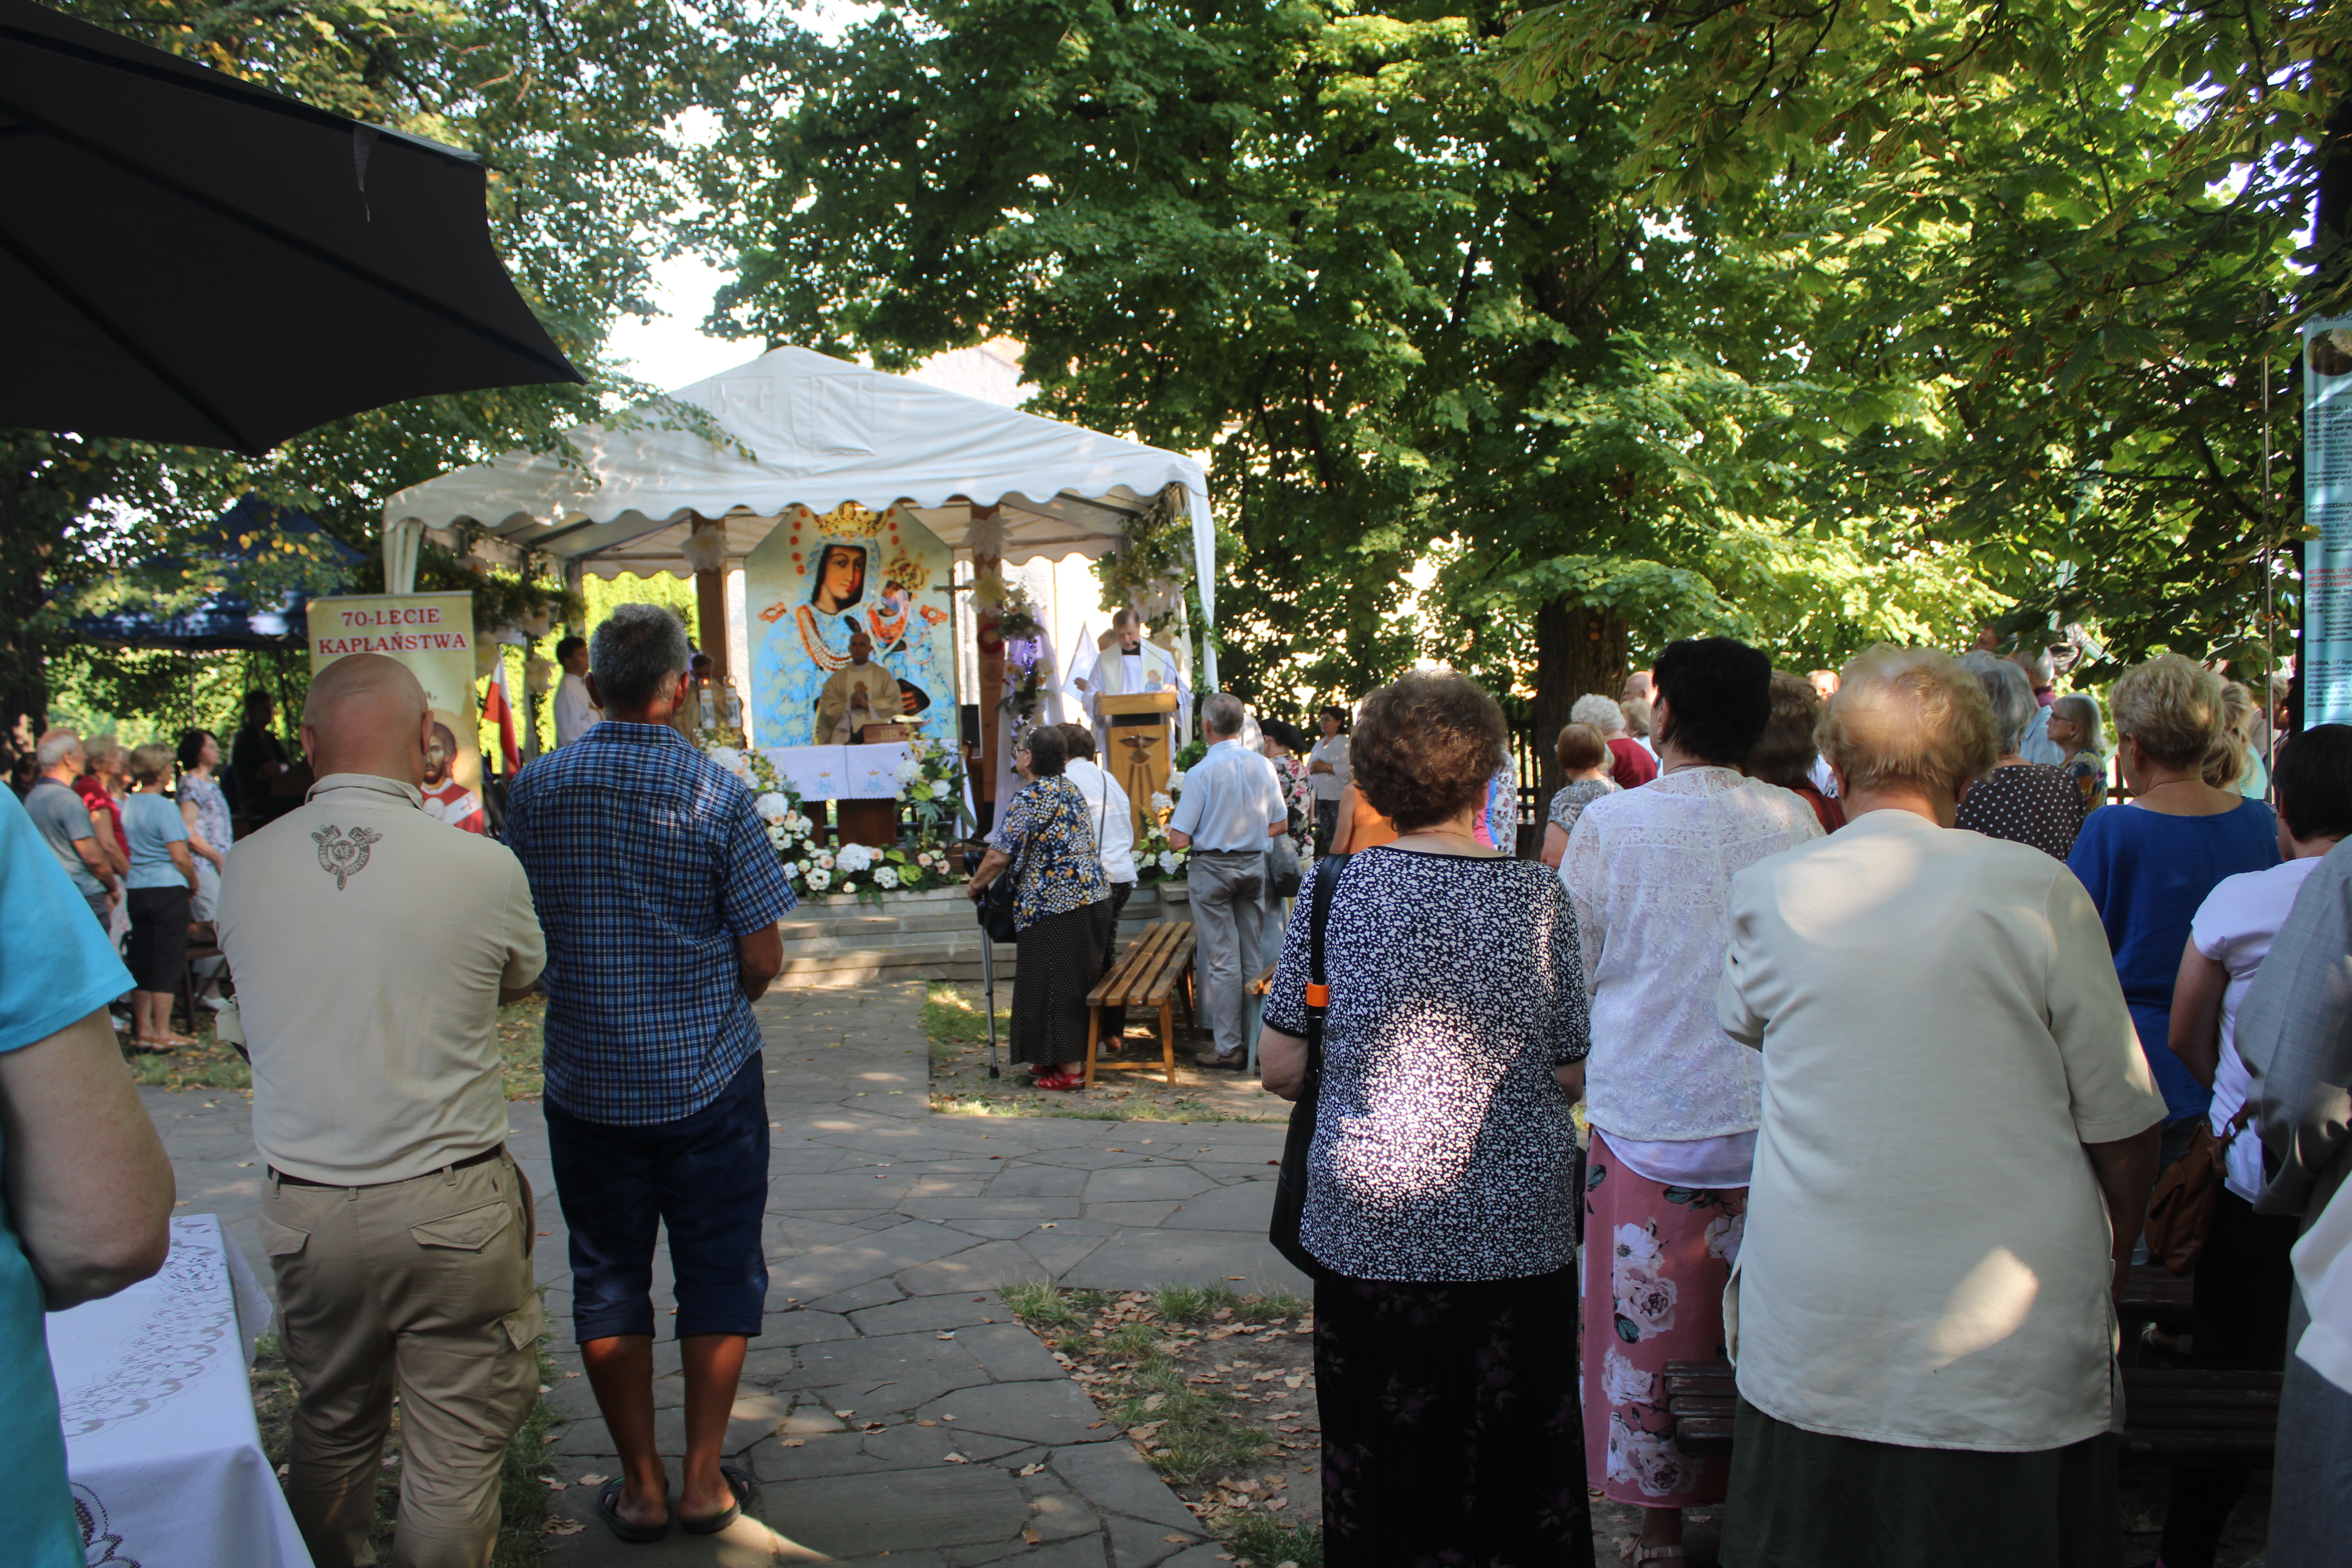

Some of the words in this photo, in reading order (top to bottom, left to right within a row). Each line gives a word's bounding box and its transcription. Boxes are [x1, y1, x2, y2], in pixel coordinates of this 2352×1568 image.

[341, 609, 440, 626] 70-LECIE
[318, 631, 466, 654] KAPŁAŃSTWA
[881, 729, 898, 739] IHS
[348, 850, 369, 873] SERVICE
